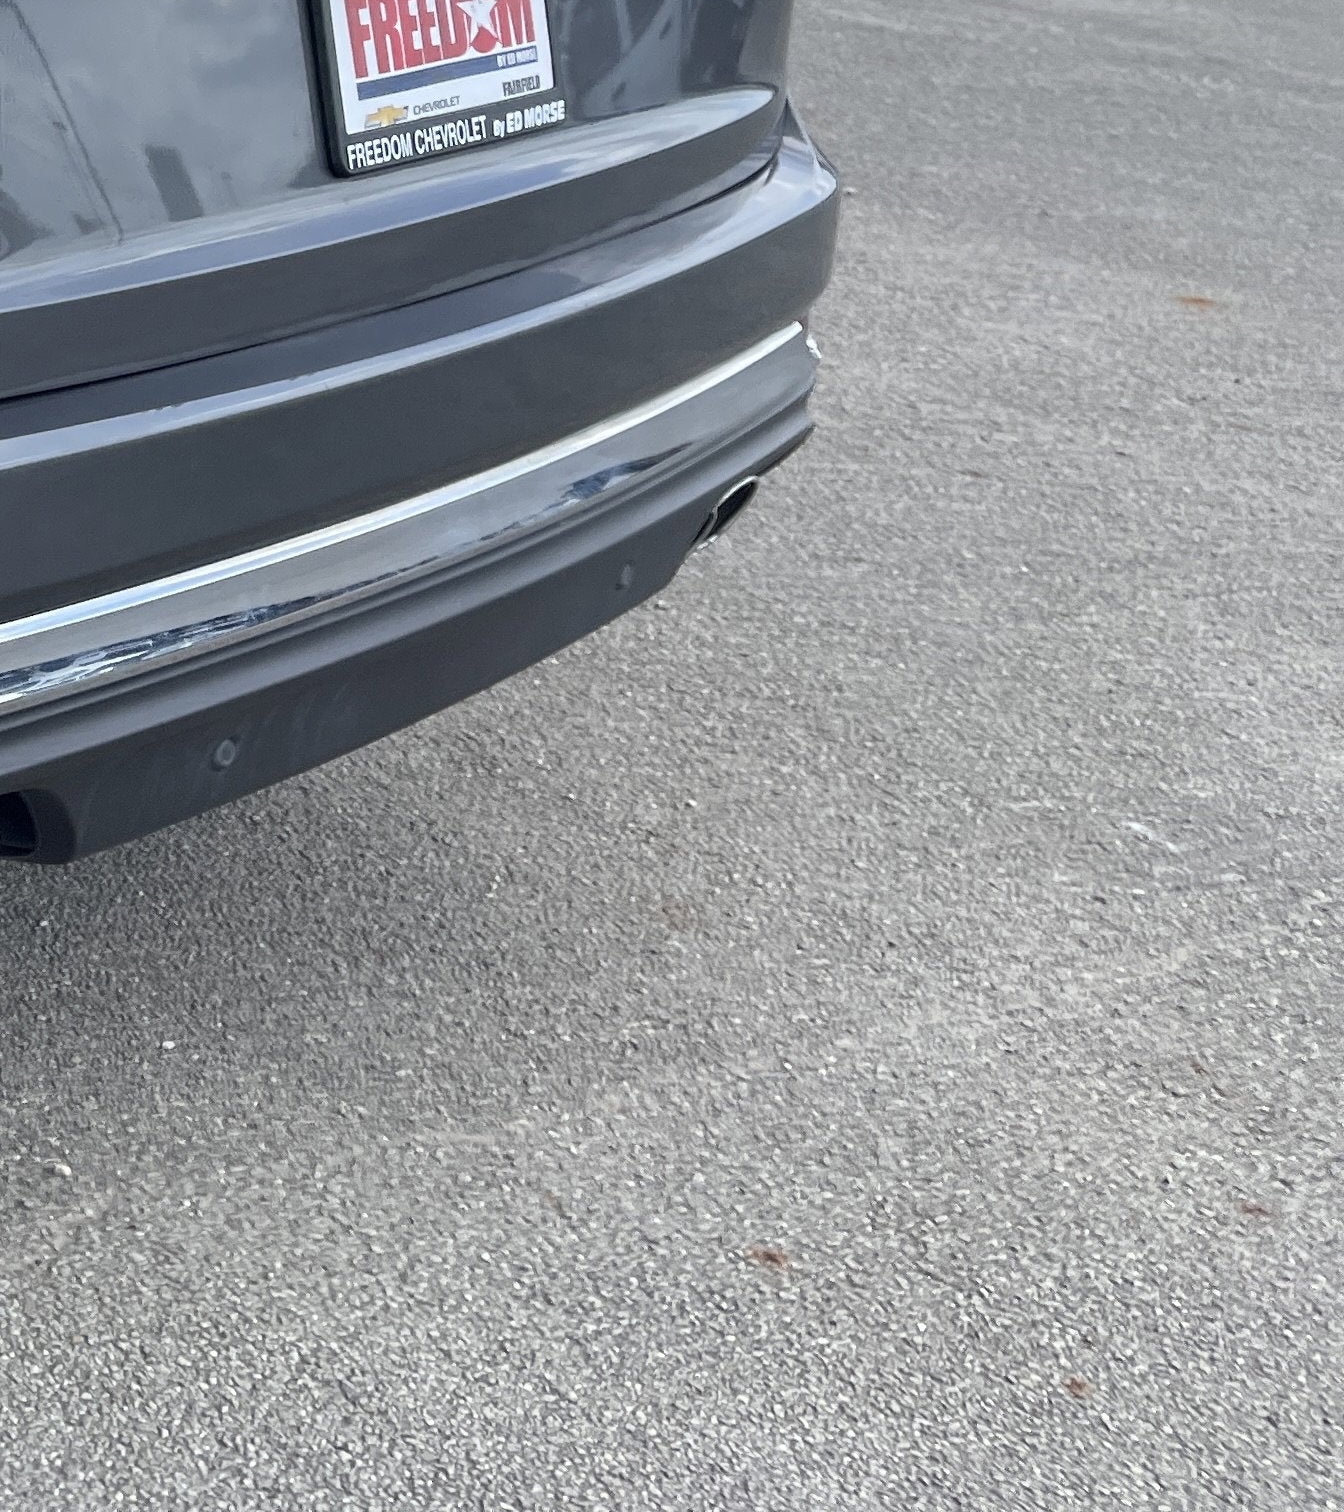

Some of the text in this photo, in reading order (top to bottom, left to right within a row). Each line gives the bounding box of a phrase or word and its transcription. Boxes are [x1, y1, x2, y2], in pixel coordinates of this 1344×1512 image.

[413, 95, 460, 116] CHEVROLET
[347, 137, 413, 170] FREEDOM
[414, 115, 487, 155] CHEVROLET
[506, 110, 523, 134] ED
[523, 99, 566, 129] MORSE
